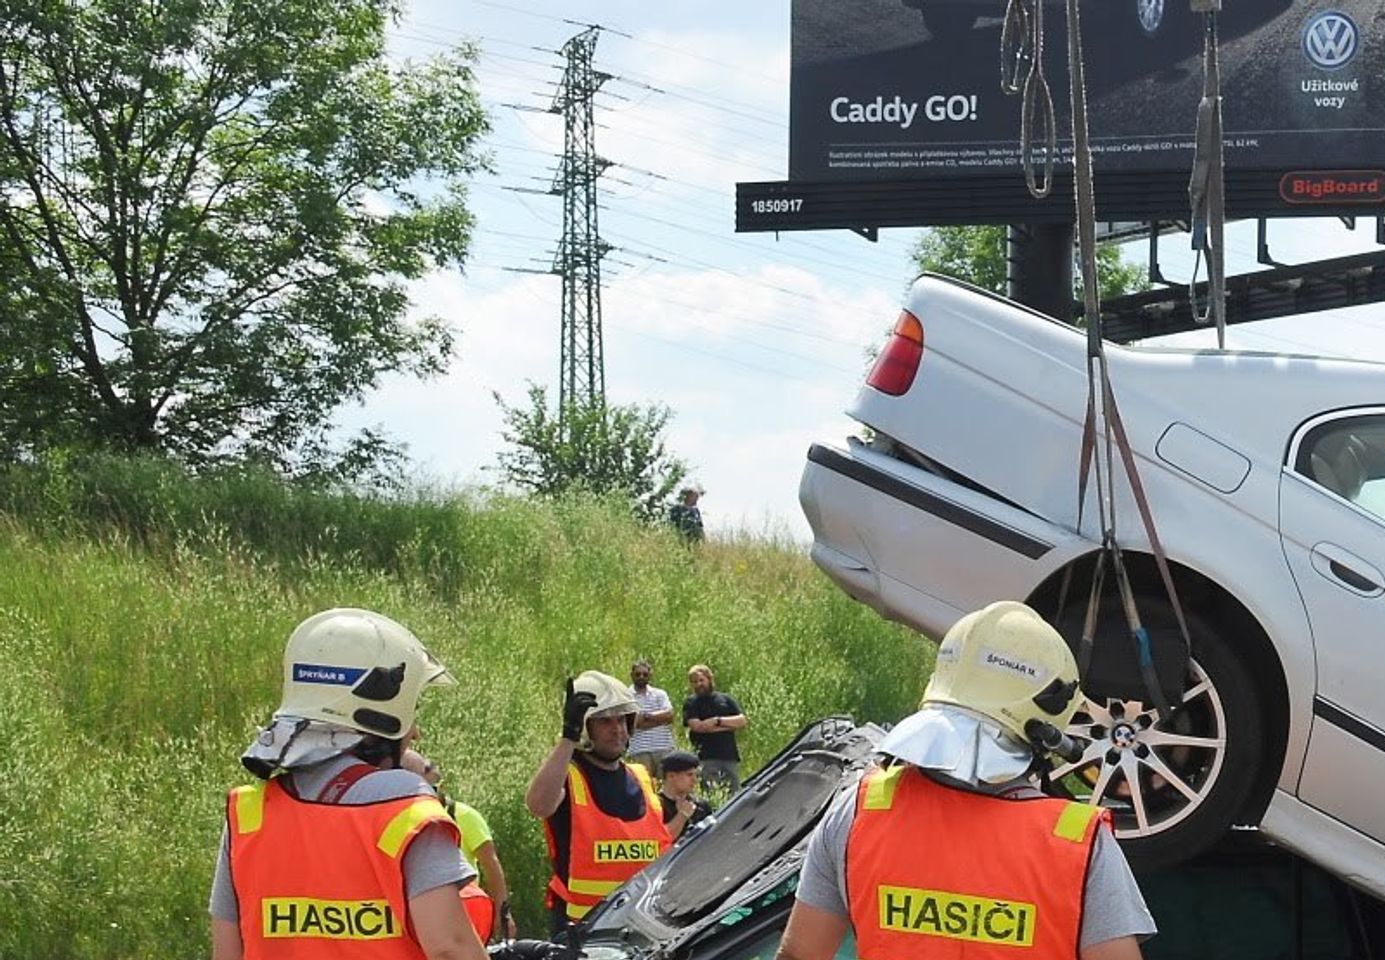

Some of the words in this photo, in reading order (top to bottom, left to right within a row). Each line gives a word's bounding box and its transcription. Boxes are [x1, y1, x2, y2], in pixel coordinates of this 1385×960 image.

[1301, 79, 1359, 92] Užitkové
[830, 95, 918, 129] Caddy
[924, 94, 978, 121] GO!
[1314, 97, 1345, 109] vozy
[1292, 180, 1378, 197] BigBoard
[752, 199, 803, 213] 1850917
[270, 902, 394, 936] HASIČI
[885, 893, 1026, 941] HASIČI
